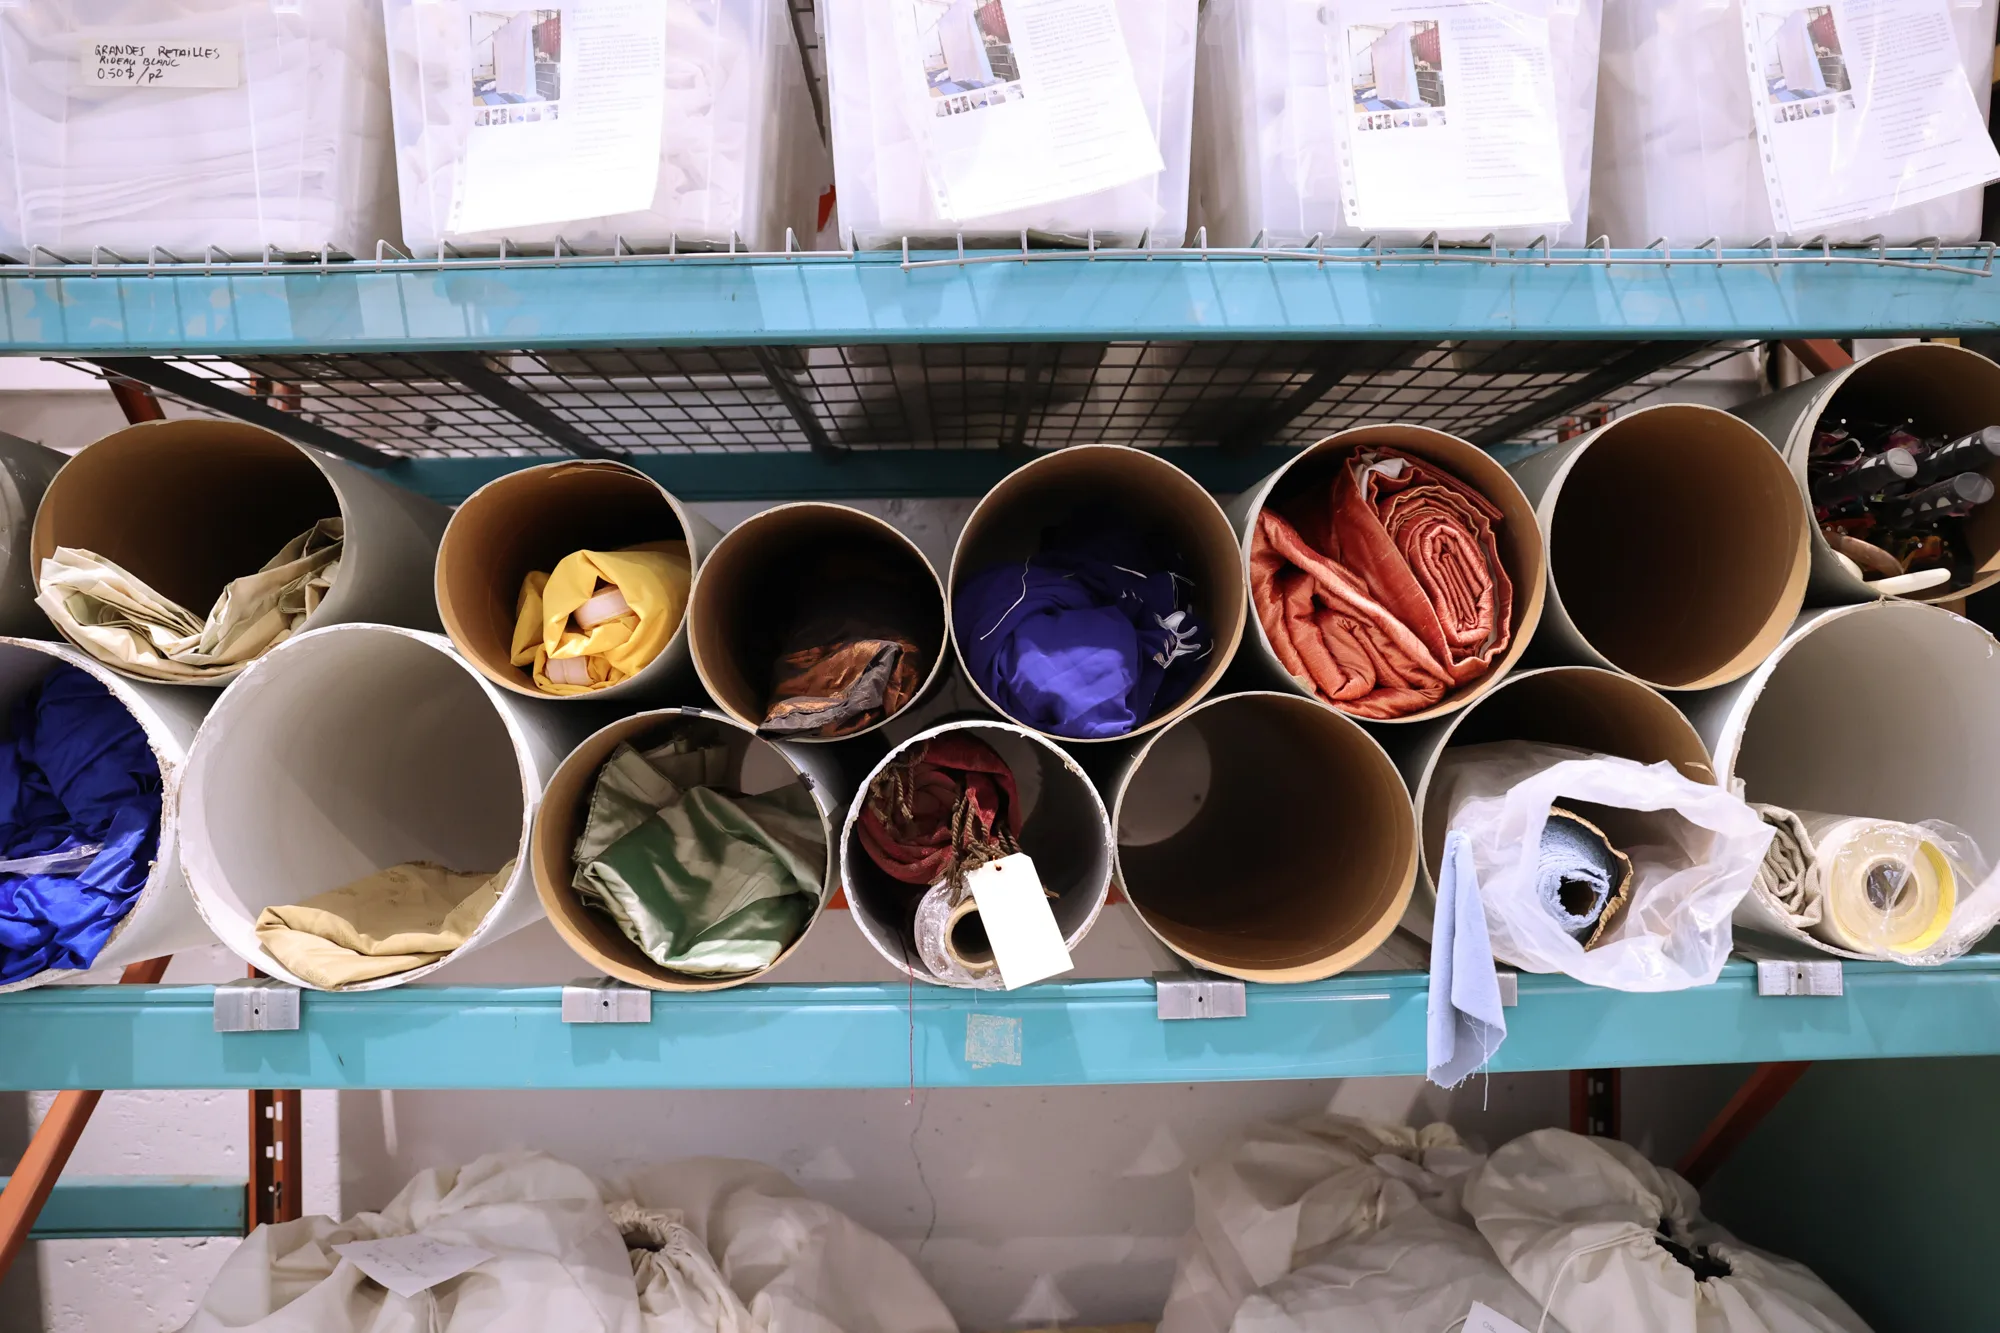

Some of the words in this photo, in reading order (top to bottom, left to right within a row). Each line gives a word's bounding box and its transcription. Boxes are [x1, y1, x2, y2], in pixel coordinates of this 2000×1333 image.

[95, 45, 145, 56] GRANDES
[100, 56, 136, 66] RIDEAU
[142, 57, 180, 67] BLANC
